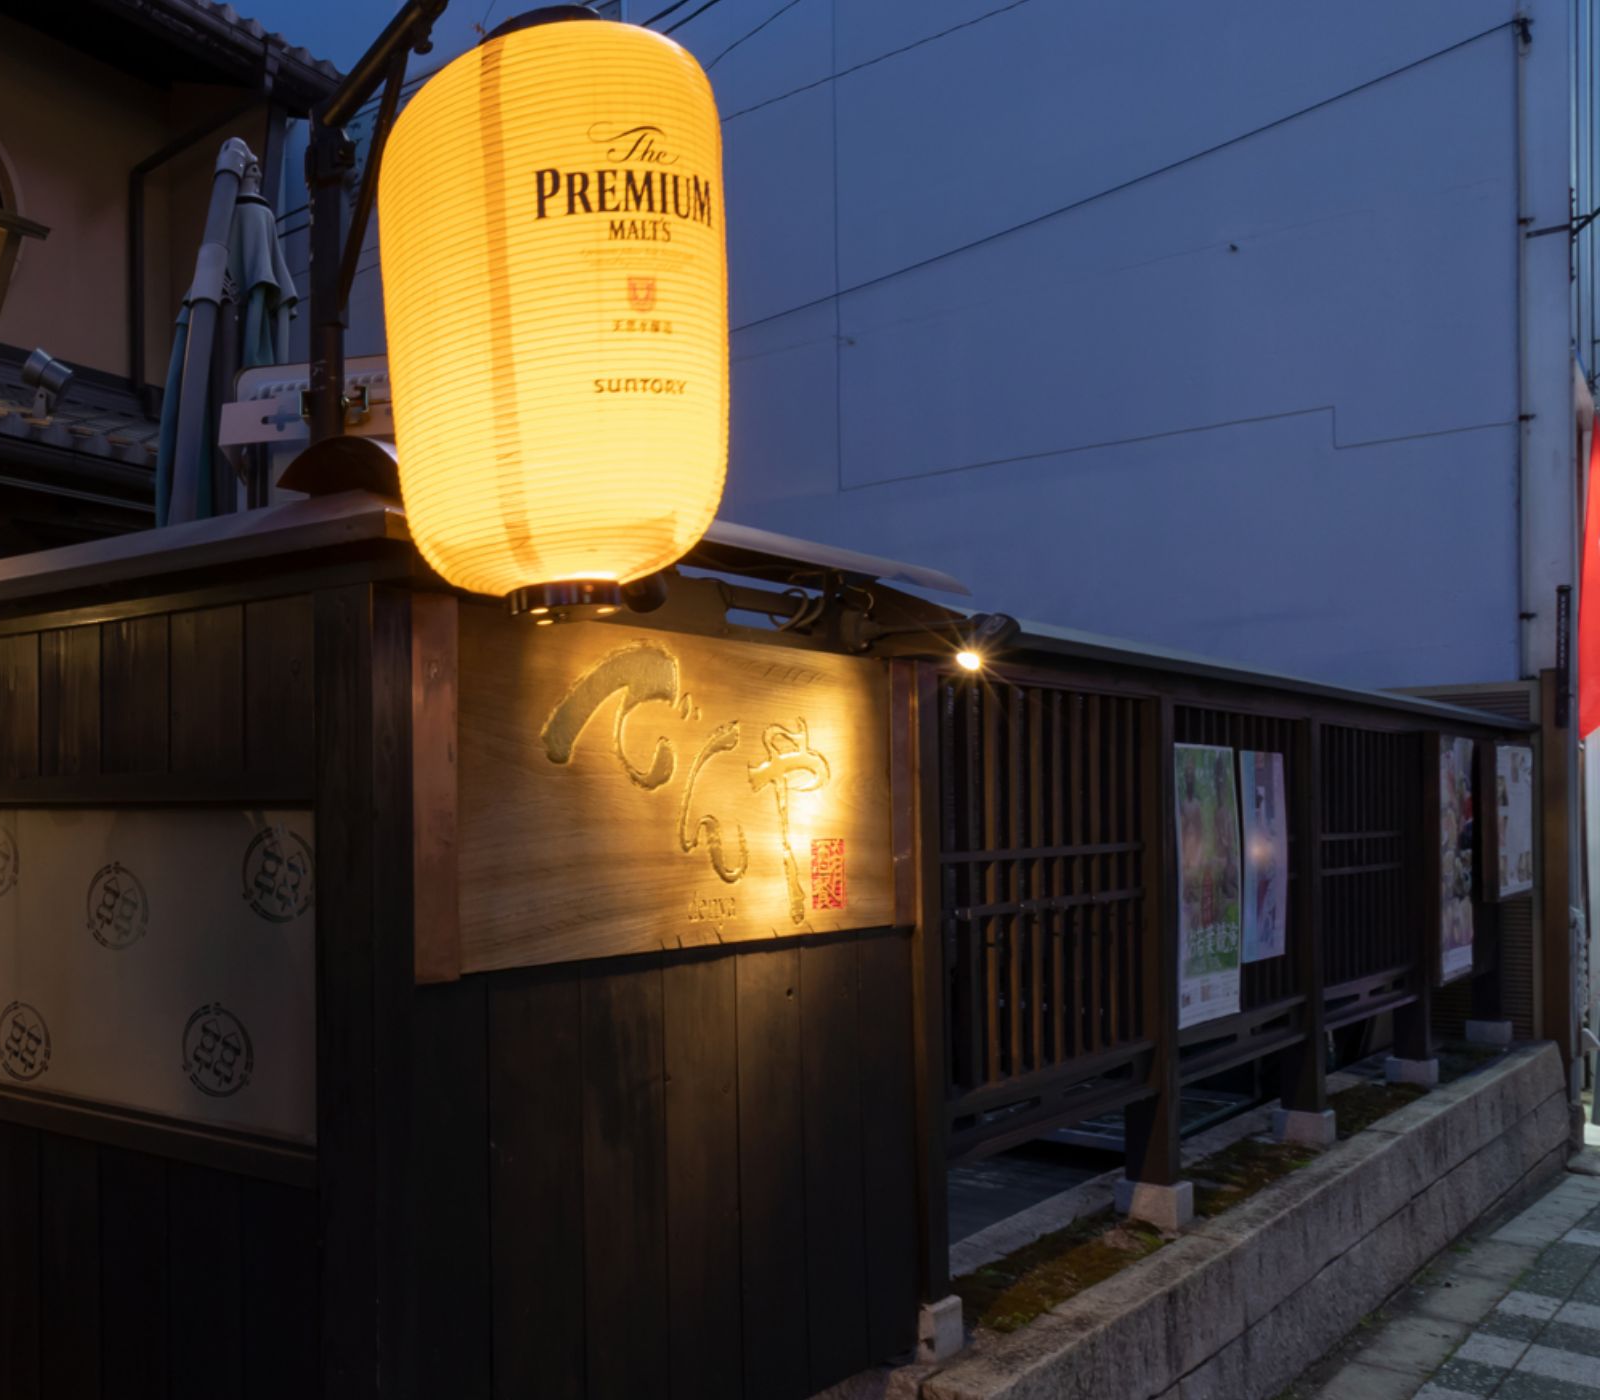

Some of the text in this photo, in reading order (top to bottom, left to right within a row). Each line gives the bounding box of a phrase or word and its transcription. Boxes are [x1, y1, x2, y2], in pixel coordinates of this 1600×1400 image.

[587, 121, 679, 165] The
[534, 168, 712, 228] PREMIUM
[608, 218, 671, 242] MALT'S
[539, 638, 831, 925] でんや
